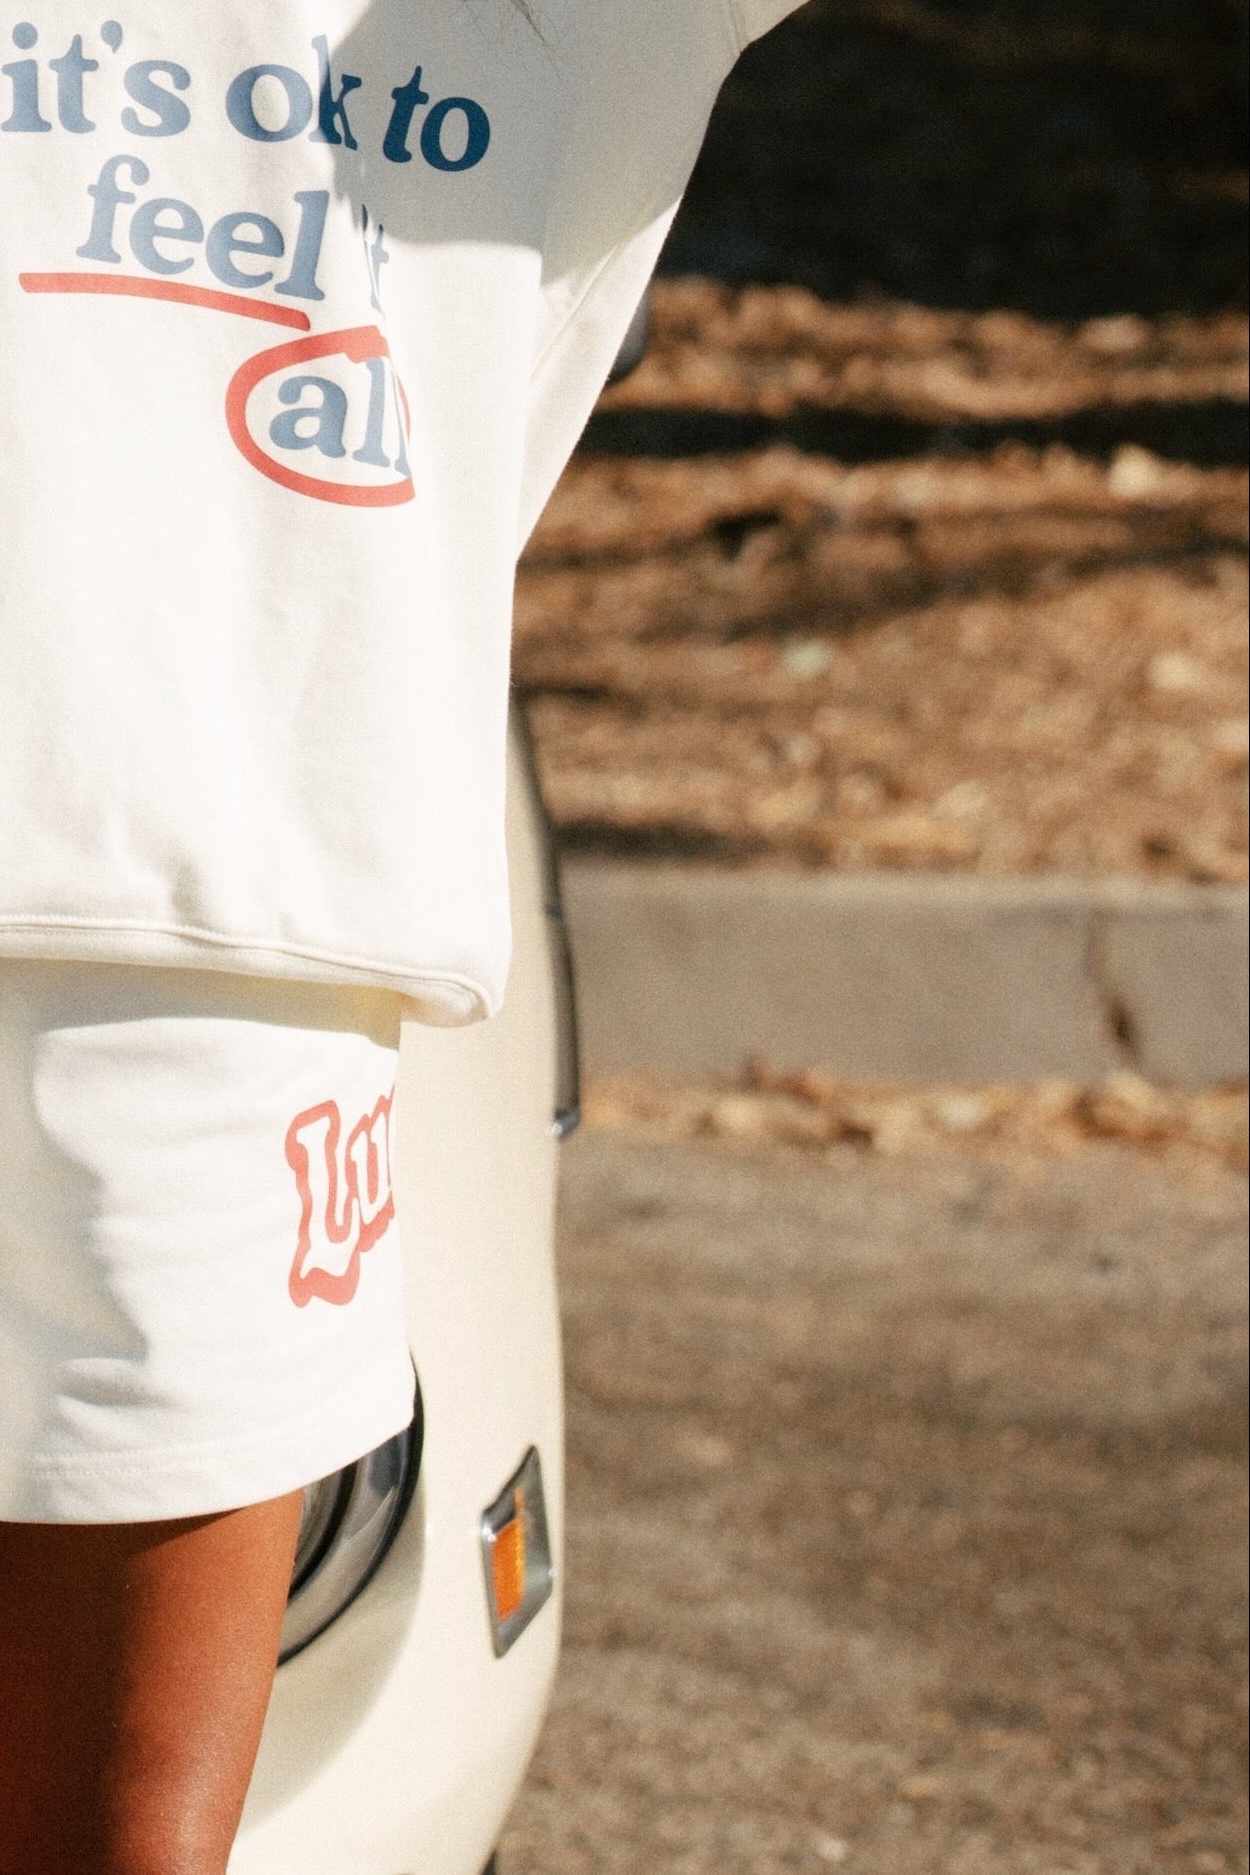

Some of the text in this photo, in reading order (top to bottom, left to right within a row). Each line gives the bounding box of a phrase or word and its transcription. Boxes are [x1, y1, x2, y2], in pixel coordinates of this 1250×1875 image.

[0, 20, 491, 172] it's ok to
[76, 153, 330, 301] feel
